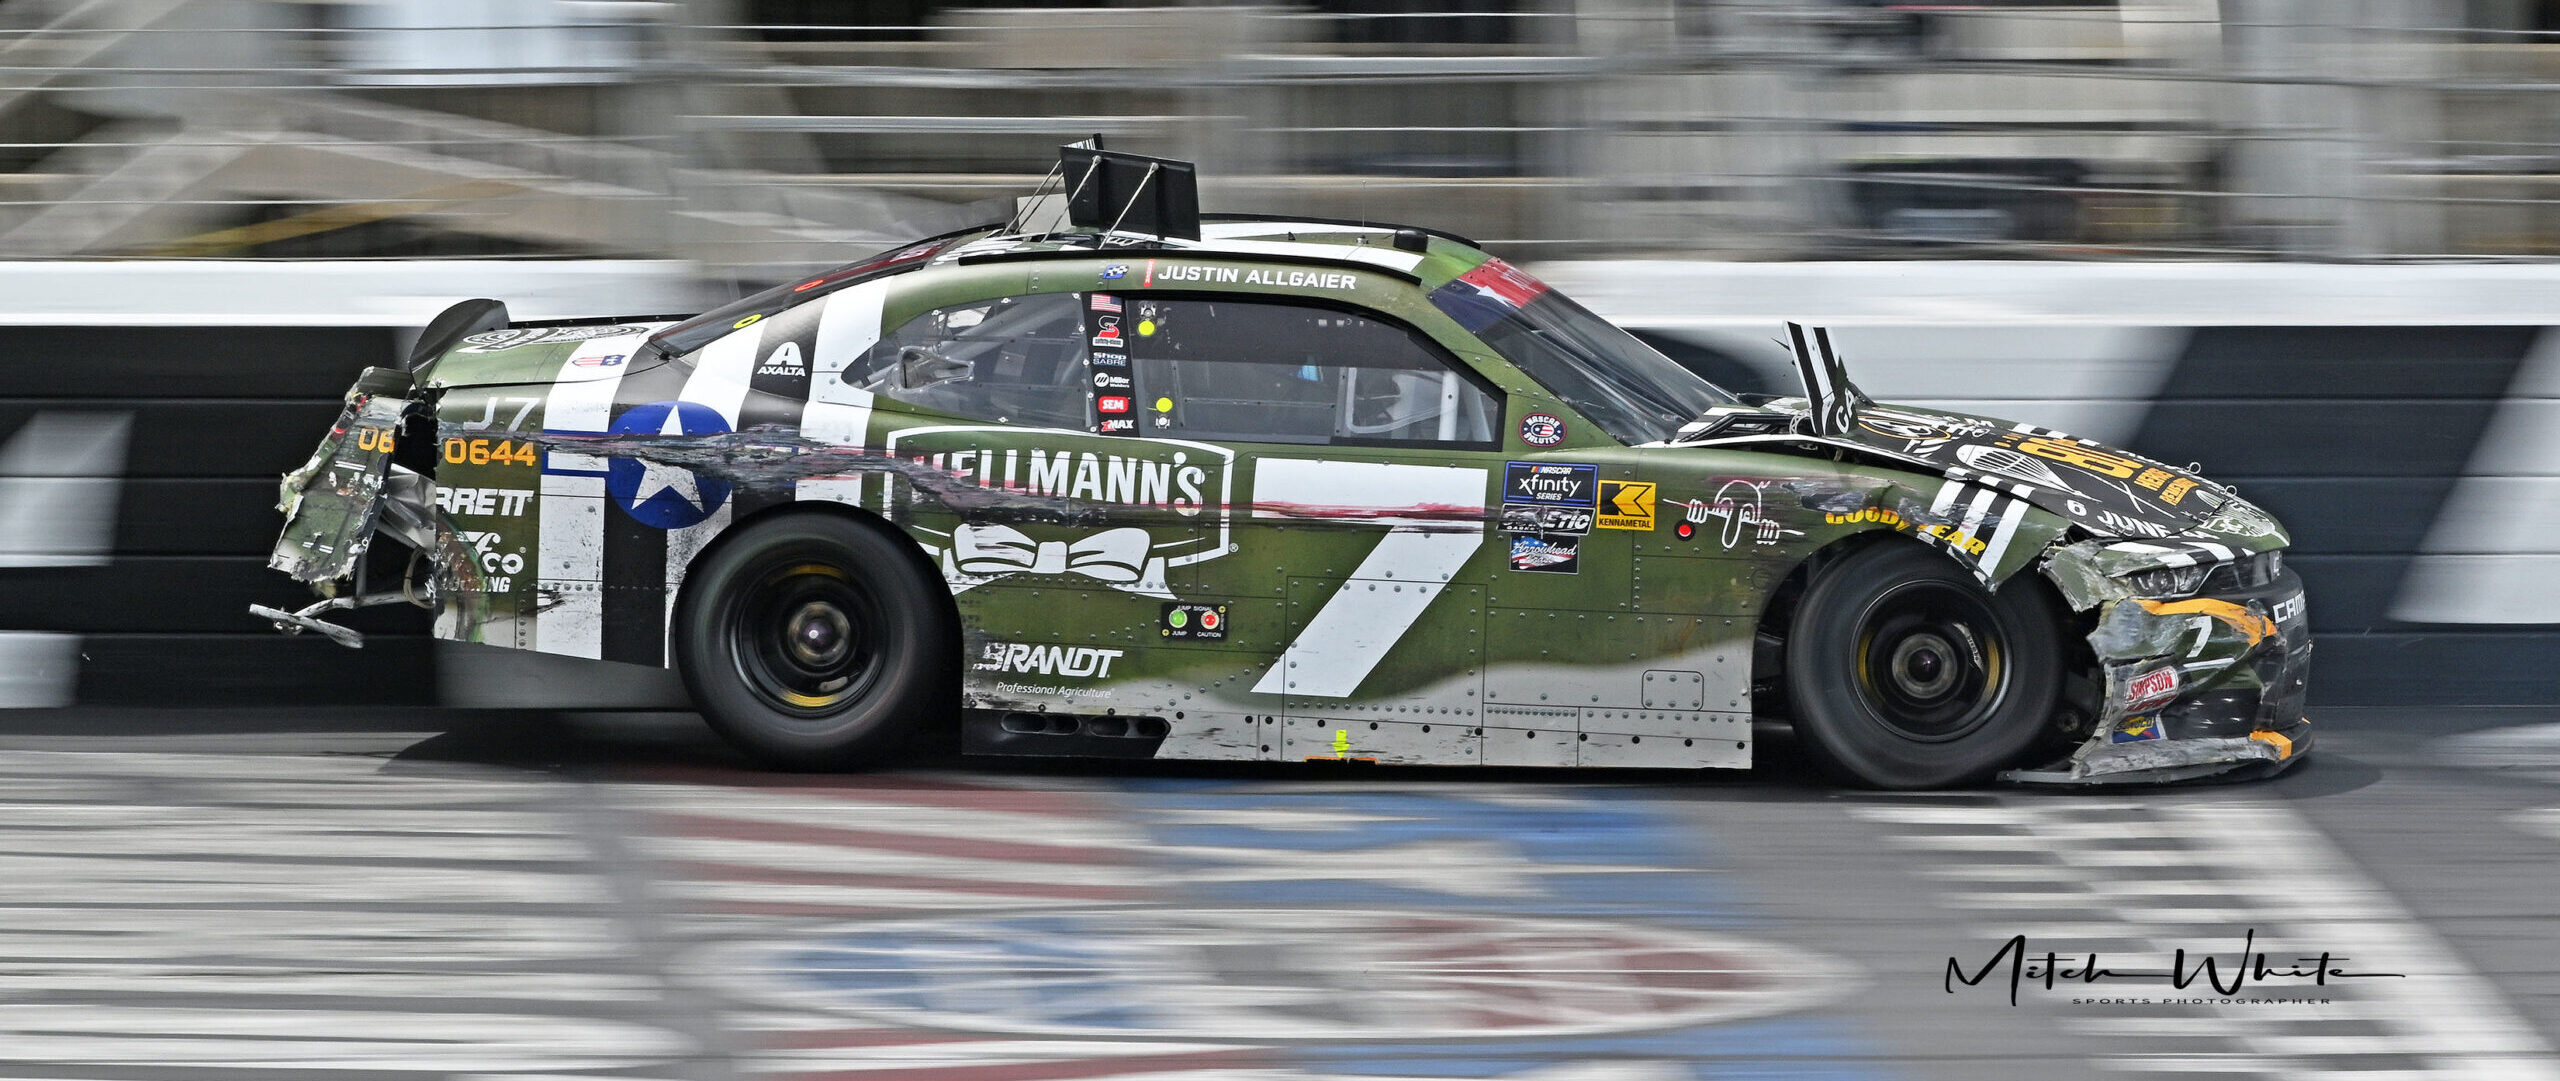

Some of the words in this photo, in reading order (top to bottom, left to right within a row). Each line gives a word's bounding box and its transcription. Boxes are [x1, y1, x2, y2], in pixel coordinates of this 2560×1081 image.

[1158, 265, 1239, 283] JUSTIN
[1245, 268, 1357, 290] ALLGAIER
[757, 366, 806, 377] AXALTA
[1102, 399, 1125, 410] SEM
[1525, 415, 1561, 428] NASCAR
[1524, 431, 1561, 444] SALUTES
[444, 437, 537, 467] 0644
[1540, 466, 1572, 475] NASCAR
[1519, 476, 1581, 497] xfinity
[1536, 492, 1562, 501] SERIES
[2067, 500, 2087, 516] 6
[1598, 518, 1652, 528] KENNAMETAL
[1250, 457, 1488, 697] 7
[2186, 615, 2213, 658] 7
[973, 642, 1124, 679] BRANDT
[996, 682, 1057, 696] Professional
[1057, 686, 1113, 699] Agriculture
